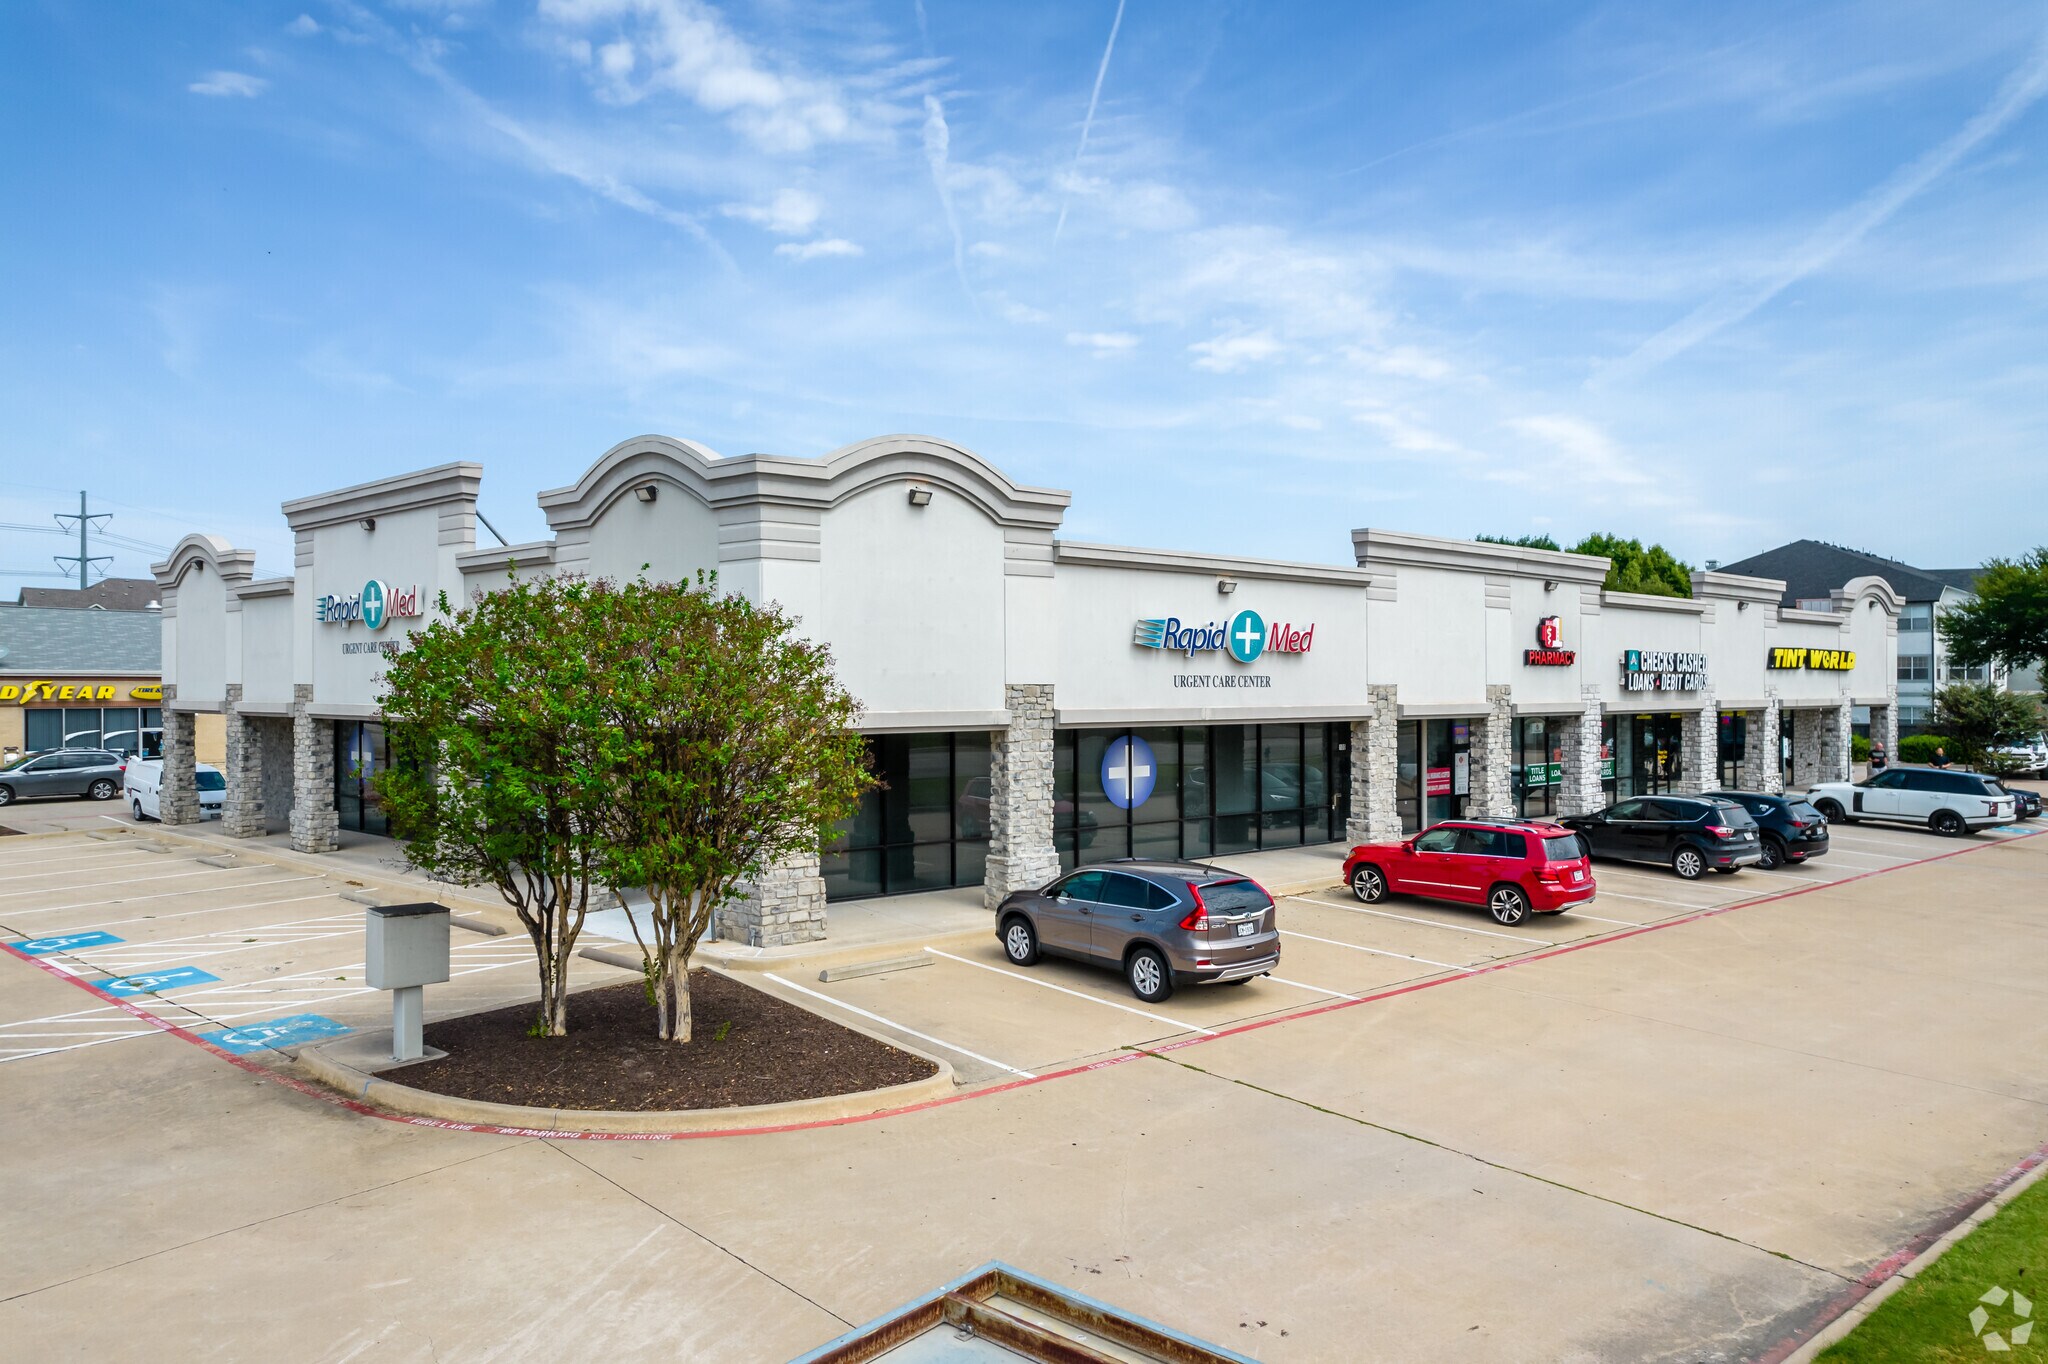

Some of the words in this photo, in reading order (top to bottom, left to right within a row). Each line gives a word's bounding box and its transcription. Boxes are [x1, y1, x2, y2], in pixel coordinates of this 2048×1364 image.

[326, 592, 361, 628] Rapid
[385, 584, 416, 617] Med
[1162, 617, 1228, 657] Rapid
[1267, 622, 1315, 653] Med
[342, 643, 363, 655] URGENT
[363, 641, 378, 653] CARE
[1529, 650, 1576, 666] PHARMACY
[1640, 651, 1675, 672] CHECKS
[1676, 652, 1708, 673] CASHED
[1774, 648, 1807, 668] TINT
[1810, 649, 1856, 670] WORLD
[1173, 674, 1211, 688] URGENT
[1212, 675, 1236, 688] CARE
[1237, 675, 1271, 688] CENTER
[1628, 673, 1655, 691] LOANS
[1661, 673, 1684, 691] DEBIT
[1684, 673, 1709, 691] CARDS
[0, 684, 116, 700] DYEAR
[1529, 774, 1546, 783] LOANS
[1531, 767, 1544, 775] TITLE
[410, 1118, 440, 1127] FIRE
[439, 1122, 476, 1131] LANE
[499, 1127, 521, 1135] NO
[521, 1129, 582, 1138] PARKING
